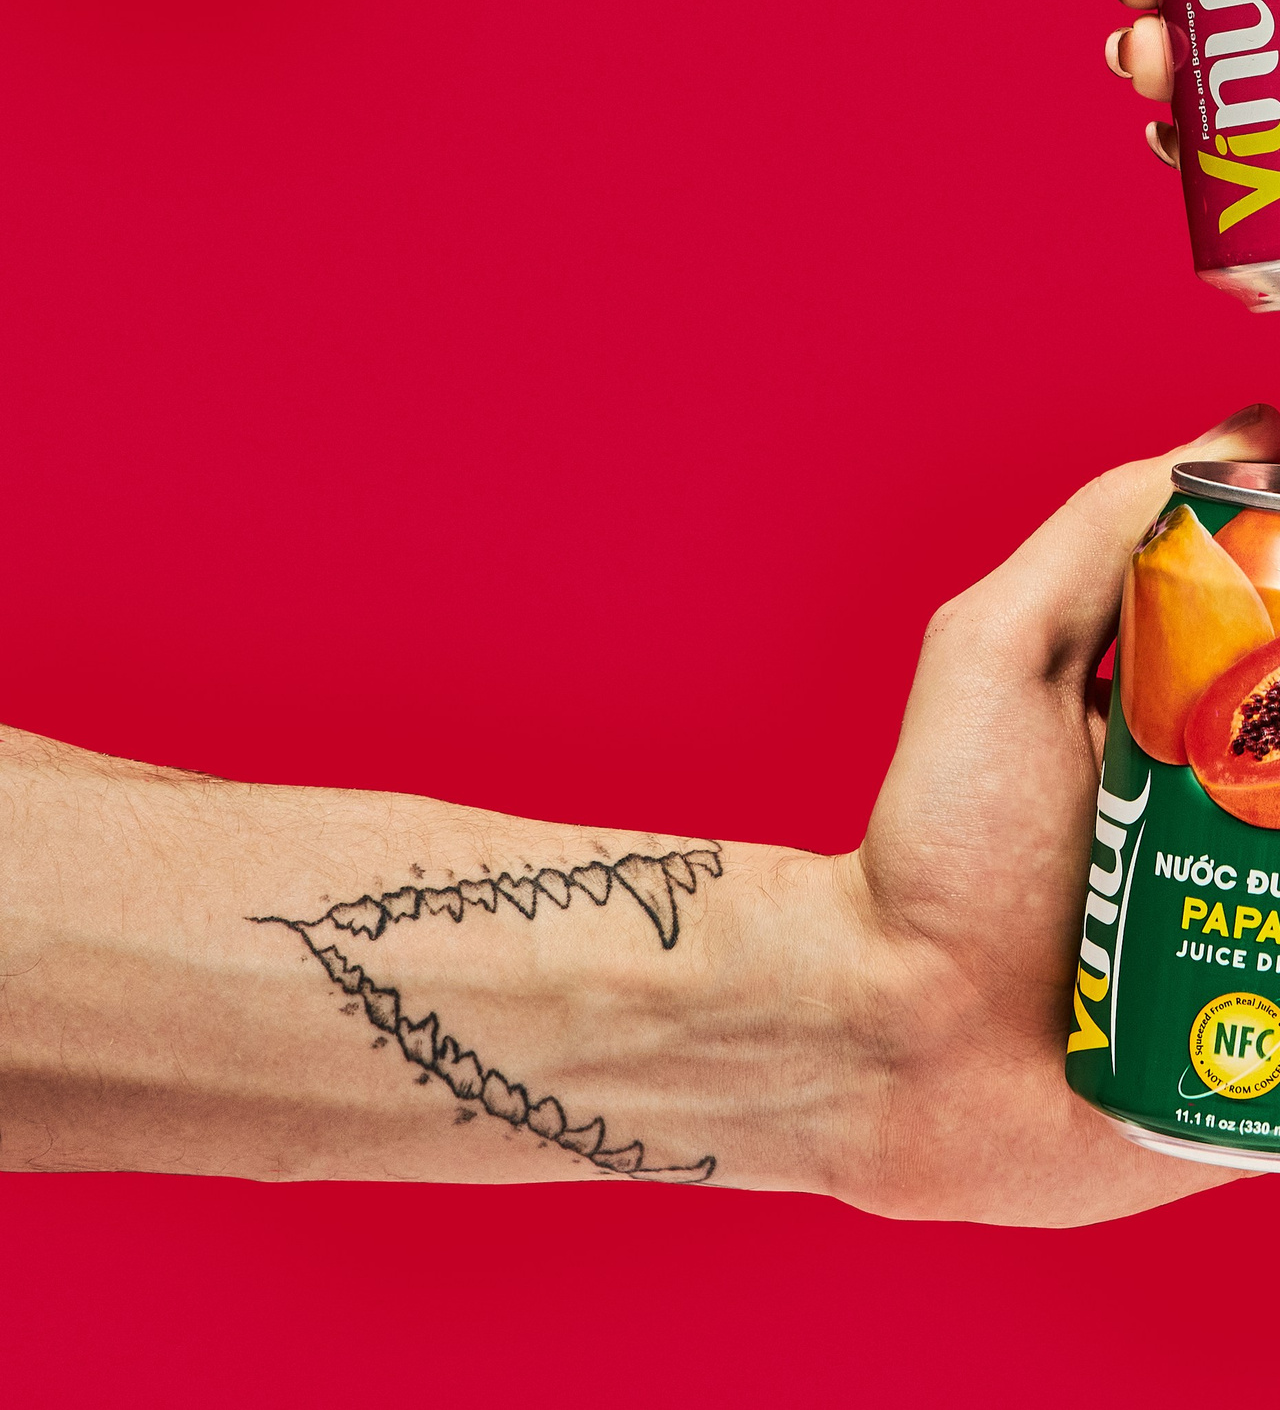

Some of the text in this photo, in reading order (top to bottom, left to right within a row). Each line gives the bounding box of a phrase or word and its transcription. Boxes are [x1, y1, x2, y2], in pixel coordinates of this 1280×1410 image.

[1186, 2, 1210, 141] Foods and Beverage
[1154, 851, 1238, 890] NƯỚC
[1175, 939, 1247, 969] JUICE
[1195, 997, 1278, 1056] Squeezed From Real Juice
[1214, 1022, 1275, 1062] NFC
[1205, 1068, 1223, 1087] NOT
[1175, 1108, 1201, 1125] 11.1
[1205, 1114, 1215, 1128] fl
[1218, 1119, 1236, 1131] oz
[1239, 1119, 1270, 1135] (330
